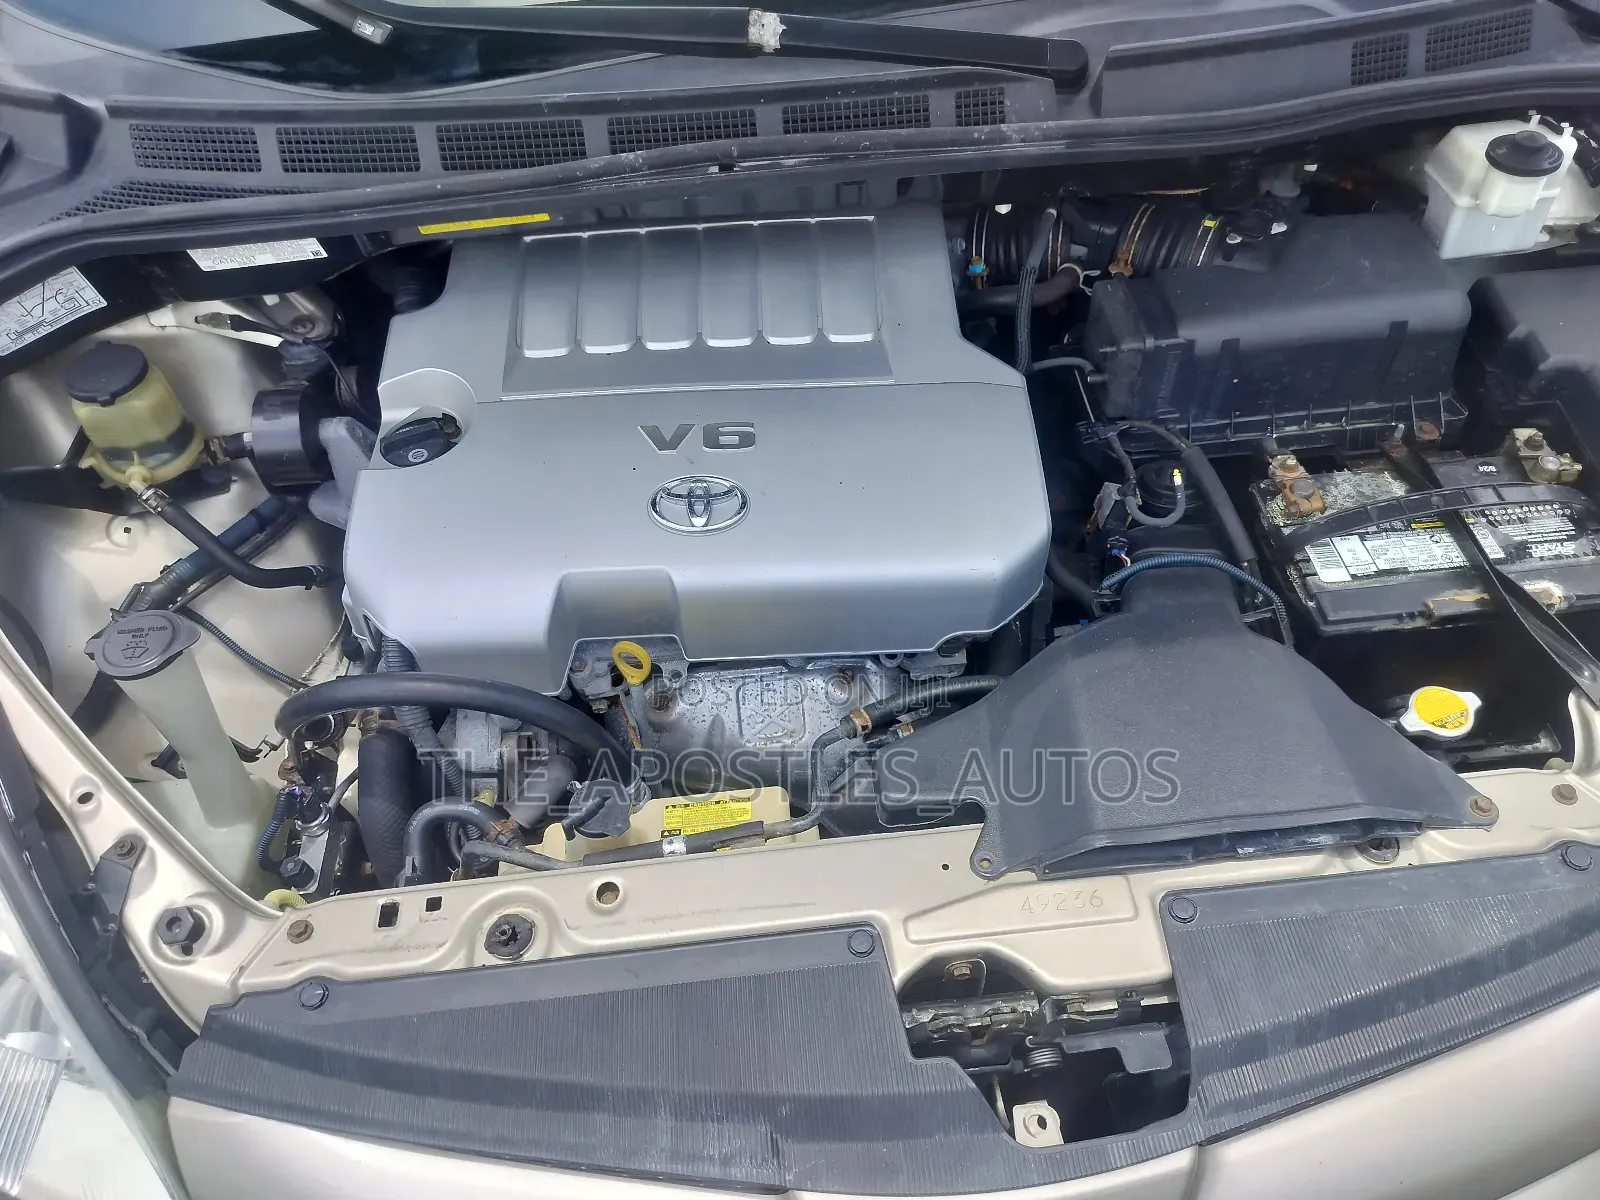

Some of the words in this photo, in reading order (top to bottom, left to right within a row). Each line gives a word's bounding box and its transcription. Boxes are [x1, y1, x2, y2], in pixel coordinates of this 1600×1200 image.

[211, 255, 258, 266] CATALYST
[636, 421, 757, 455] V6
[1433, 710, 1467, 727] CAUTION
[1020, 889, 1104, 914] 49236
